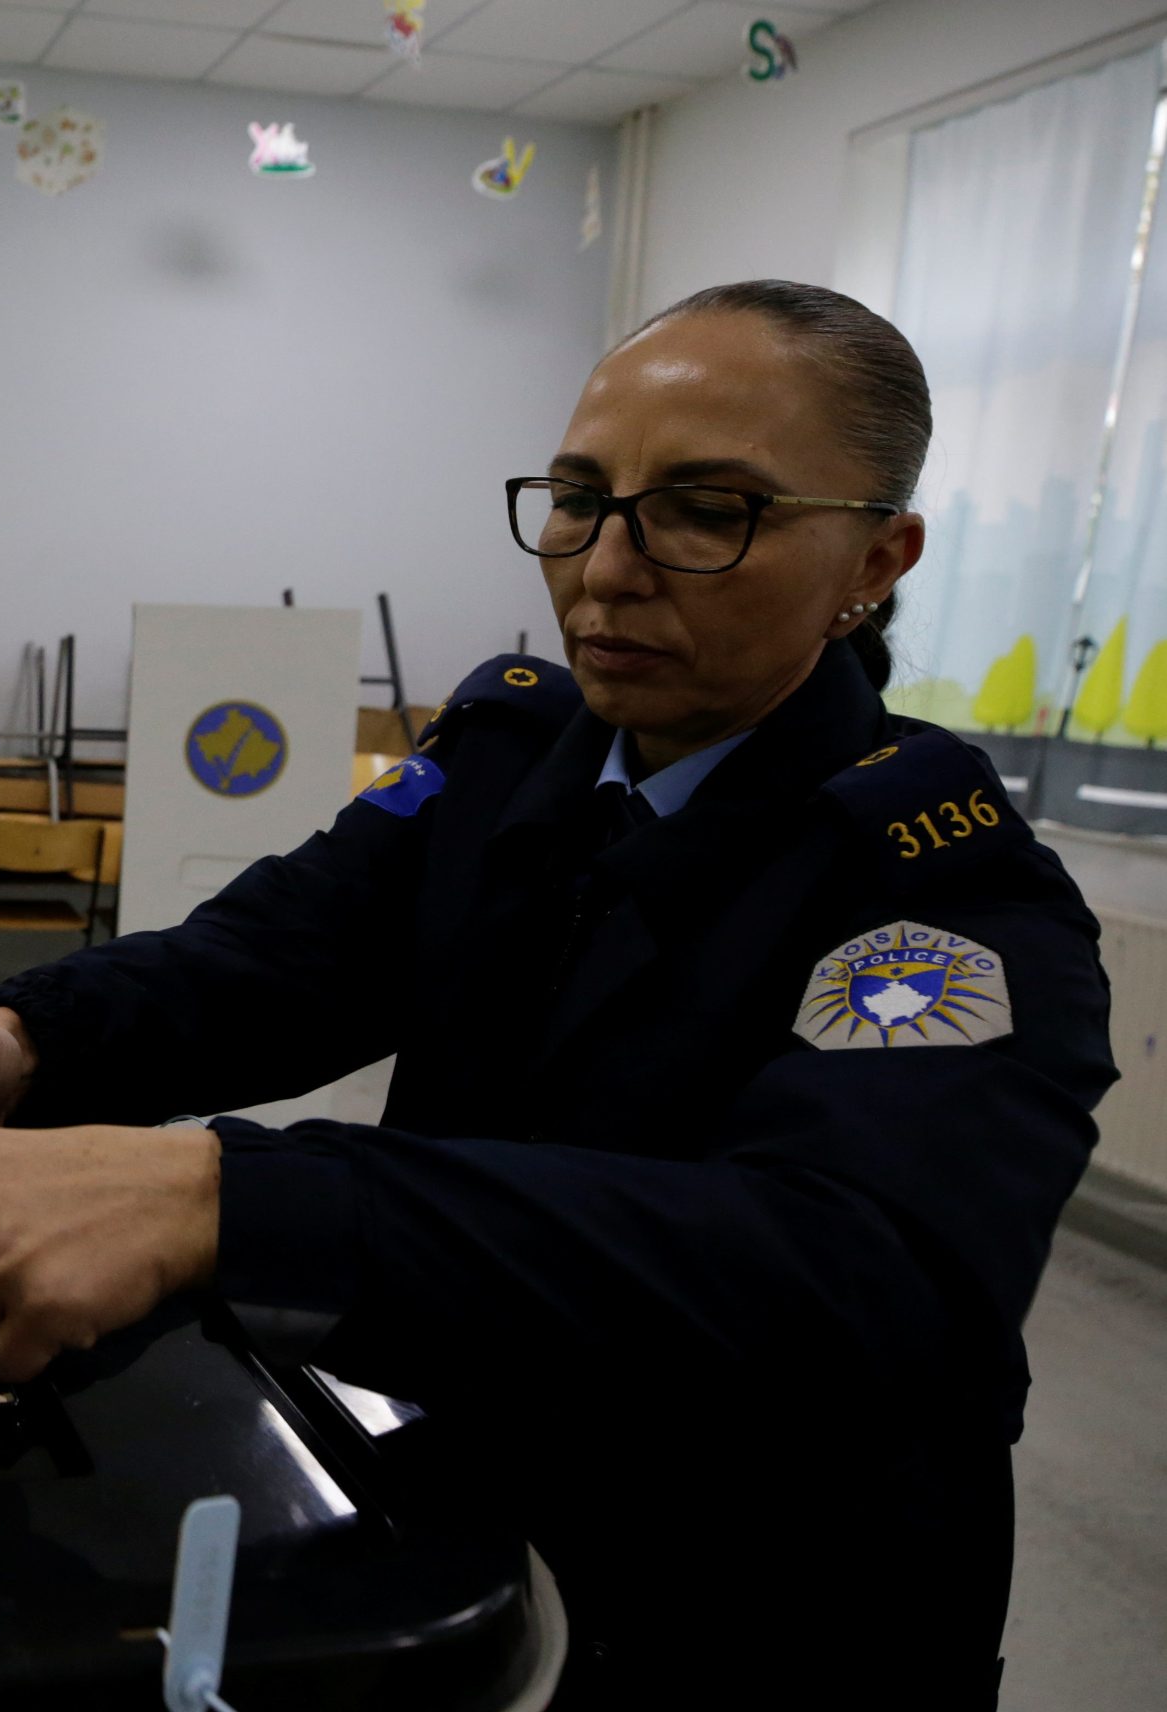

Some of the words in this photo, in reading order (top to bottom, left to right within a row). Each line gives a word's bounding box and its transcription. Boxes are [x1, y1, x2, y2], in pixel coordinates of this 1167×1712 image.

[749, 19, 775, 82] S
[887, 789, 999, 859] 3136
[817, 931, 995, 977] KOSOVO
[854, 950, 947, 970] POLICE
